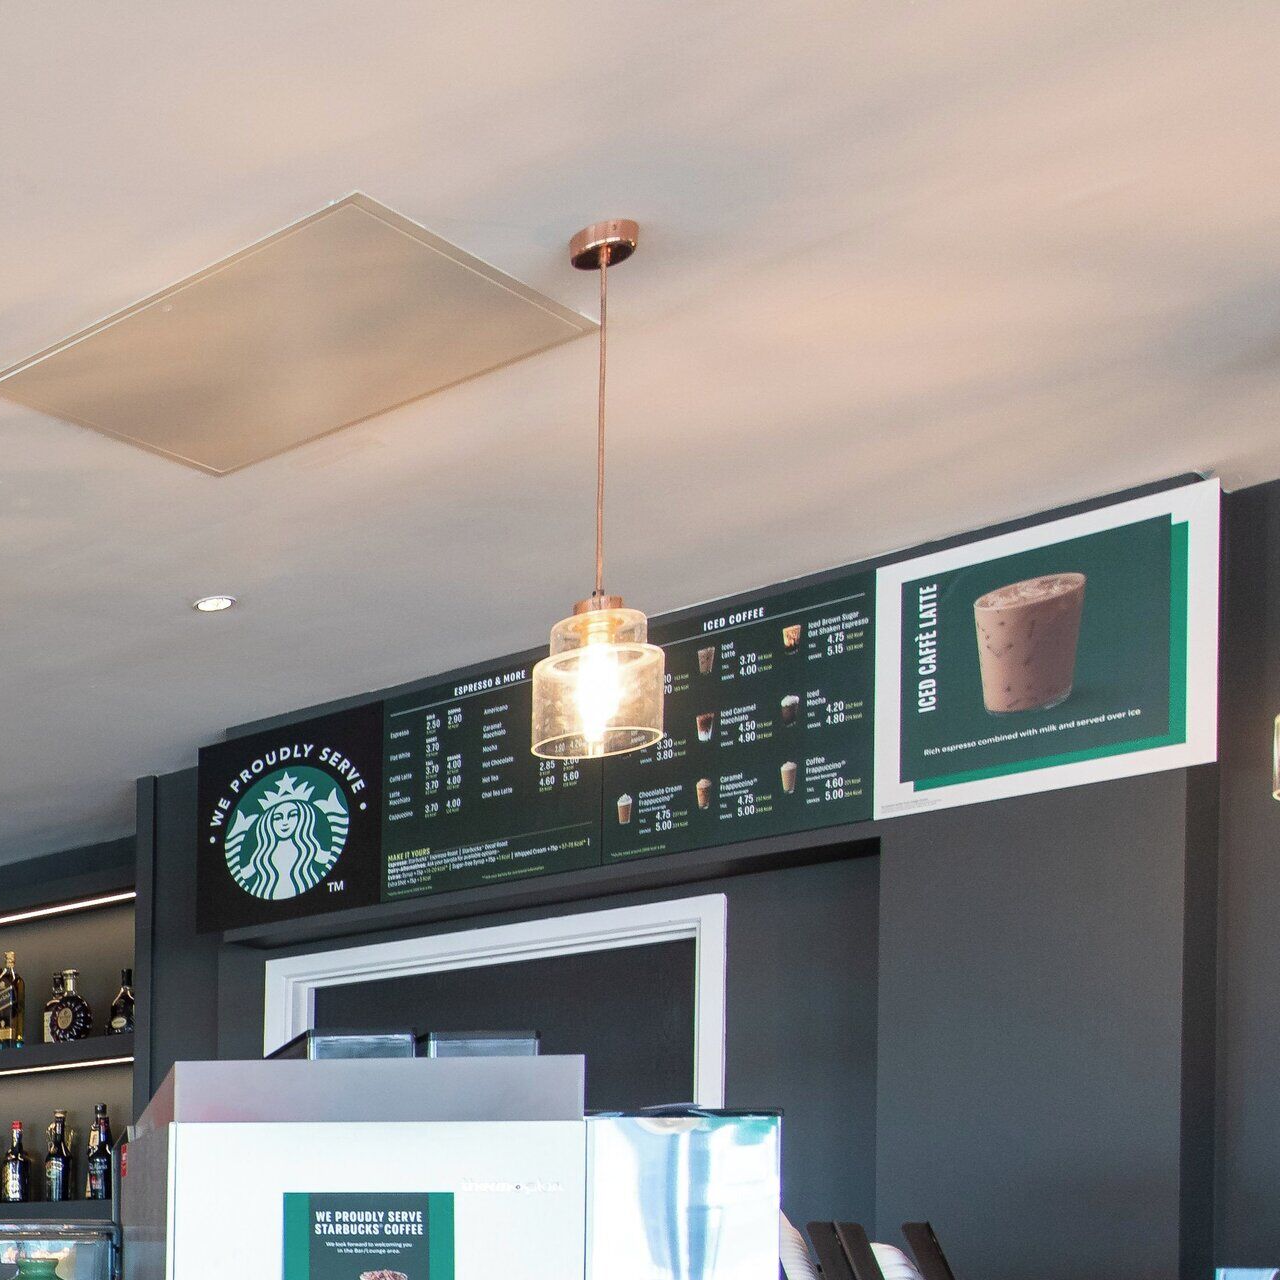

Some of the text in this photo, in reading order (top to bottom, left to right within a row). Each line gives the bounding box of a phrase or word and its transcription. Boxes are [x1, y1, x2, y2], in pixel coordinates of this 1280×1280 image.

[703, 607, 765, 632] ICED COFFEE
[842, 617, 869, 630] Espresso
[827, 631, 844, 644] 4.75
[721, 650, 736, 659] Latte
[827, 643, 843, 656] 5.15
[914, 584, 937, 714] ICED CAFFÈ LATTE
[739, 652, 756, 665] 3.70
[739, 663, 757, 676] 4.00
[454, 669, 526, 697] ESPRESSO & MORE
[826, 700, 844, 713] 4.20
[826, 712, 845, 725] 4.80
[739, 720, 756, 732] 4.50
[923, 707, 1141, 757] Rich espresso combined with milk and served over ice
[738, 731, 756, 743] 4.90
[657, 749, 673, 761] 3.80
[540, 759, 556, 771] 2.85
[209, 743, 366, 828] WE PROUDLY SERVE
[447, 774, 462, 786] 4.00
[825, 776, 844, 789] 4.60
[738, 794, 754, 805] 4.75
[825, 788, 844, 801] 5.00
[424, 802, 439, 814] 3.70
[446, 797, 461, 808] 4.00
[738, 805, 755, 817] 5.00
[656, 809, 671, 821] 4.75
[656, 819, 672, 832] 5.00
[327, 881, 344, 893] TM
[315, 1211, 423, 1223] WE PROUDLY SERVE
[384, 1223, 424, 1235] COFFEE
[375, 1241, 402, 1249] welcoming
